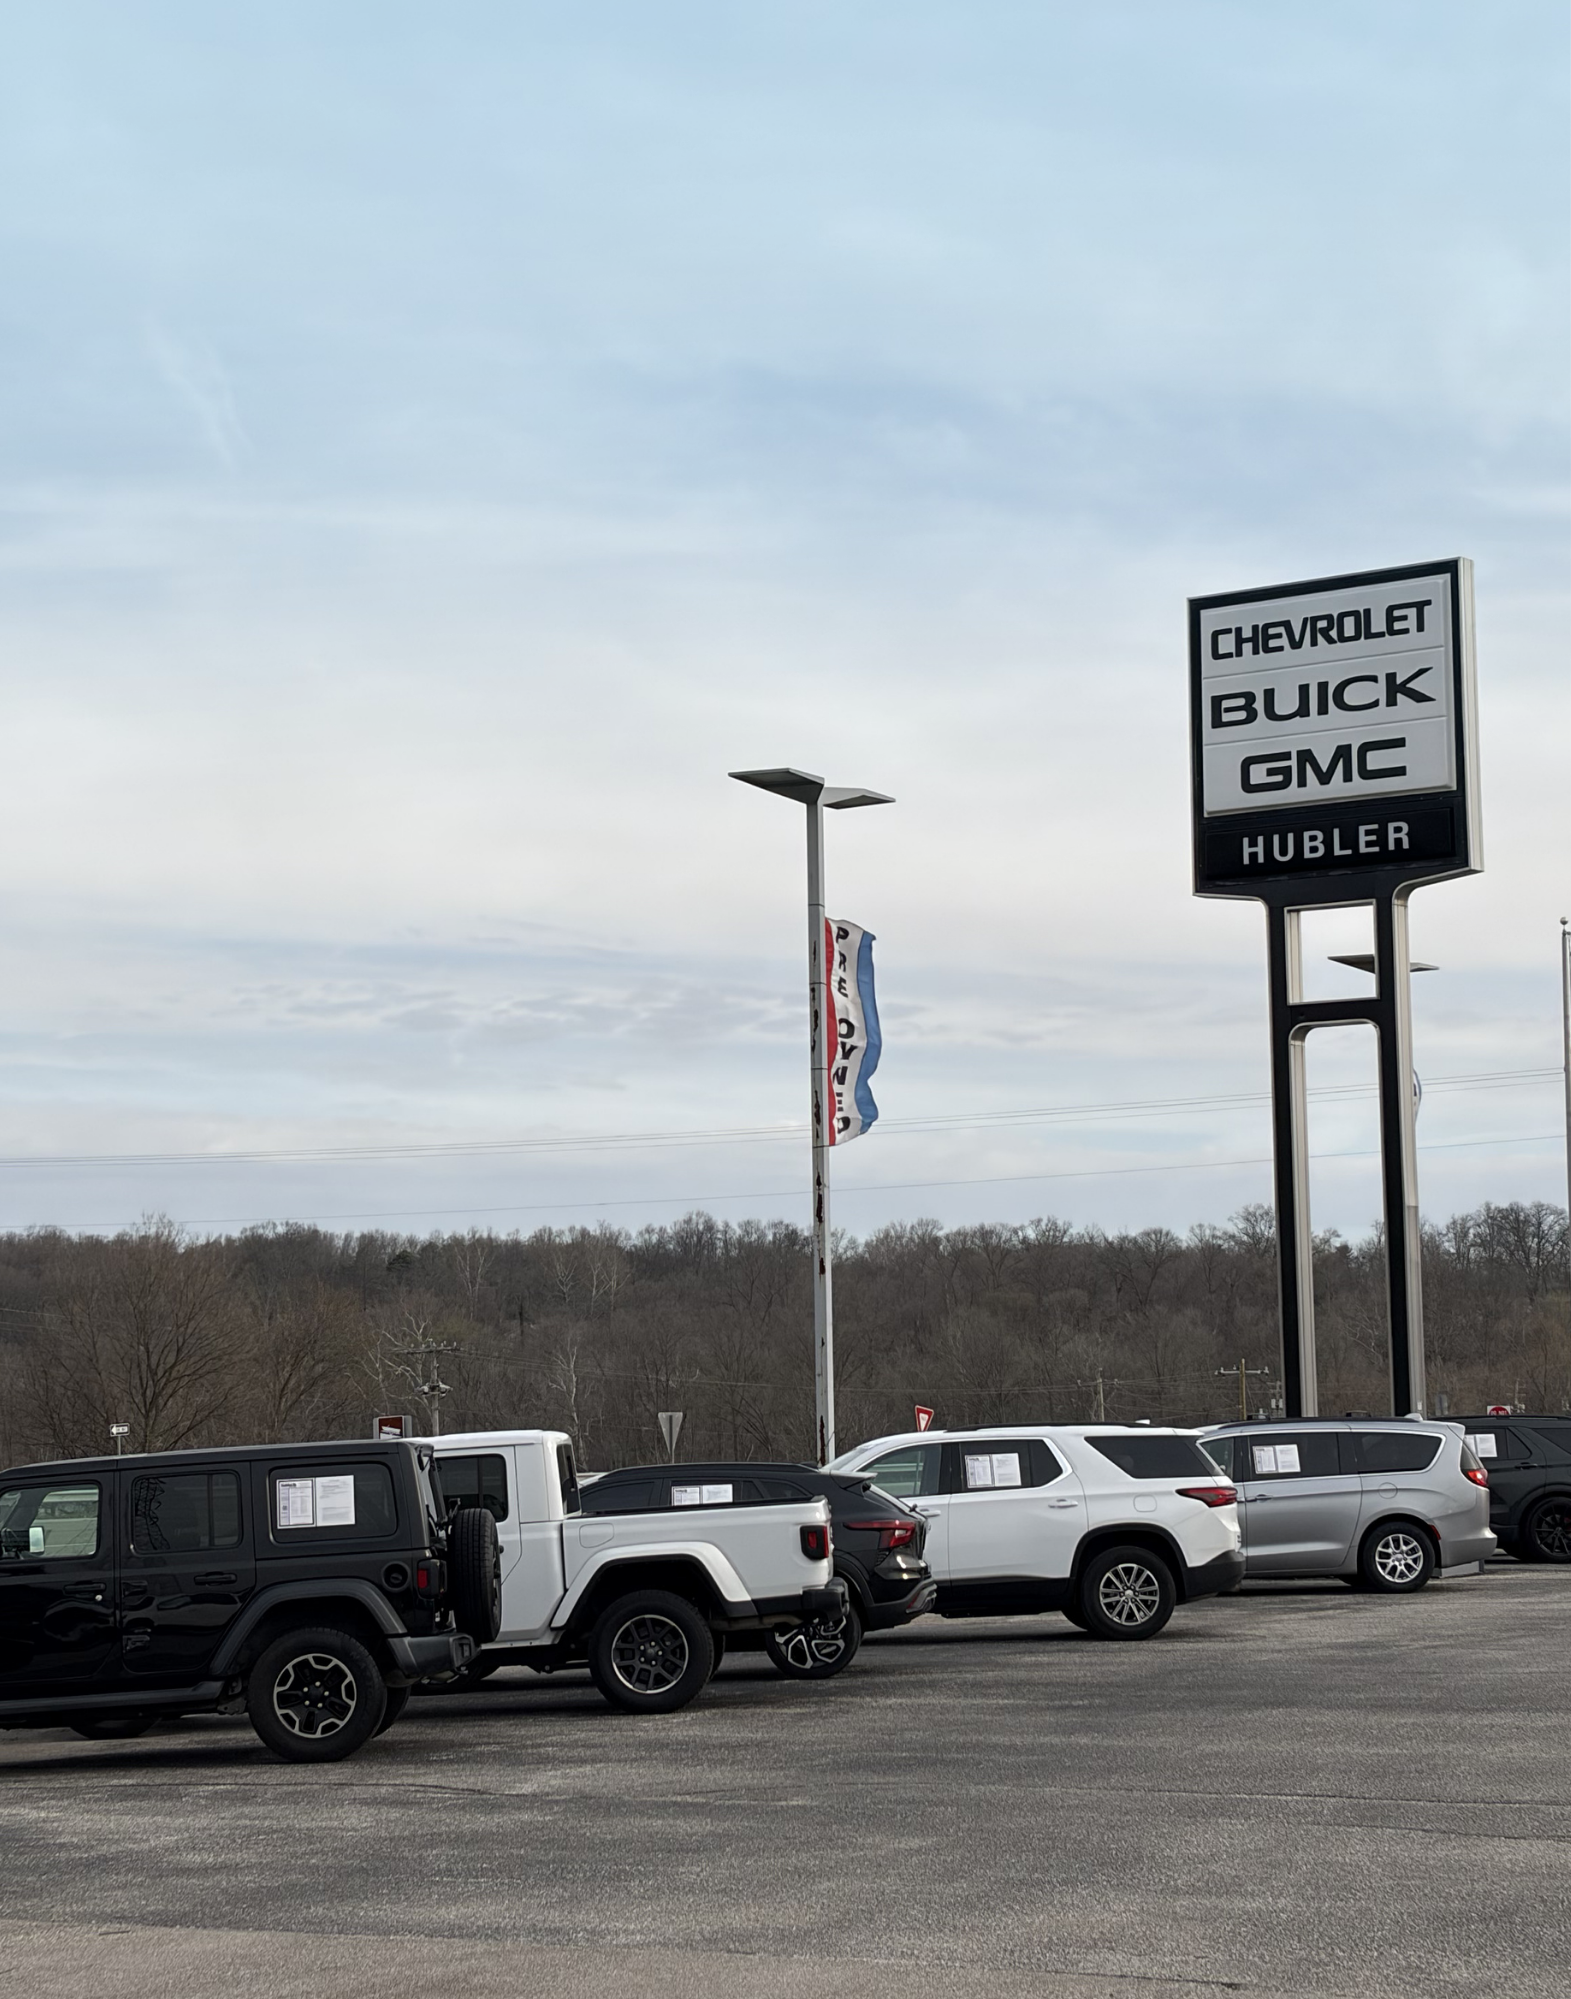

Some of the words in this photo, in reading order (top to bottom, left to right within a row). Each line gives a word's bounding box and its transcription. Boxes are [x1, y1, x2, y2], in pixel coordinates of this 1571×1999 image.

[1211, 599, 1432, 660] CHEVROLET
[1211, 666, 1437, 729] BUICK
[1240, 737, 1407, 794] GMC
[1242, 821, 1411, 865] HUBLER
[836, 926, 850, 998] PRE
